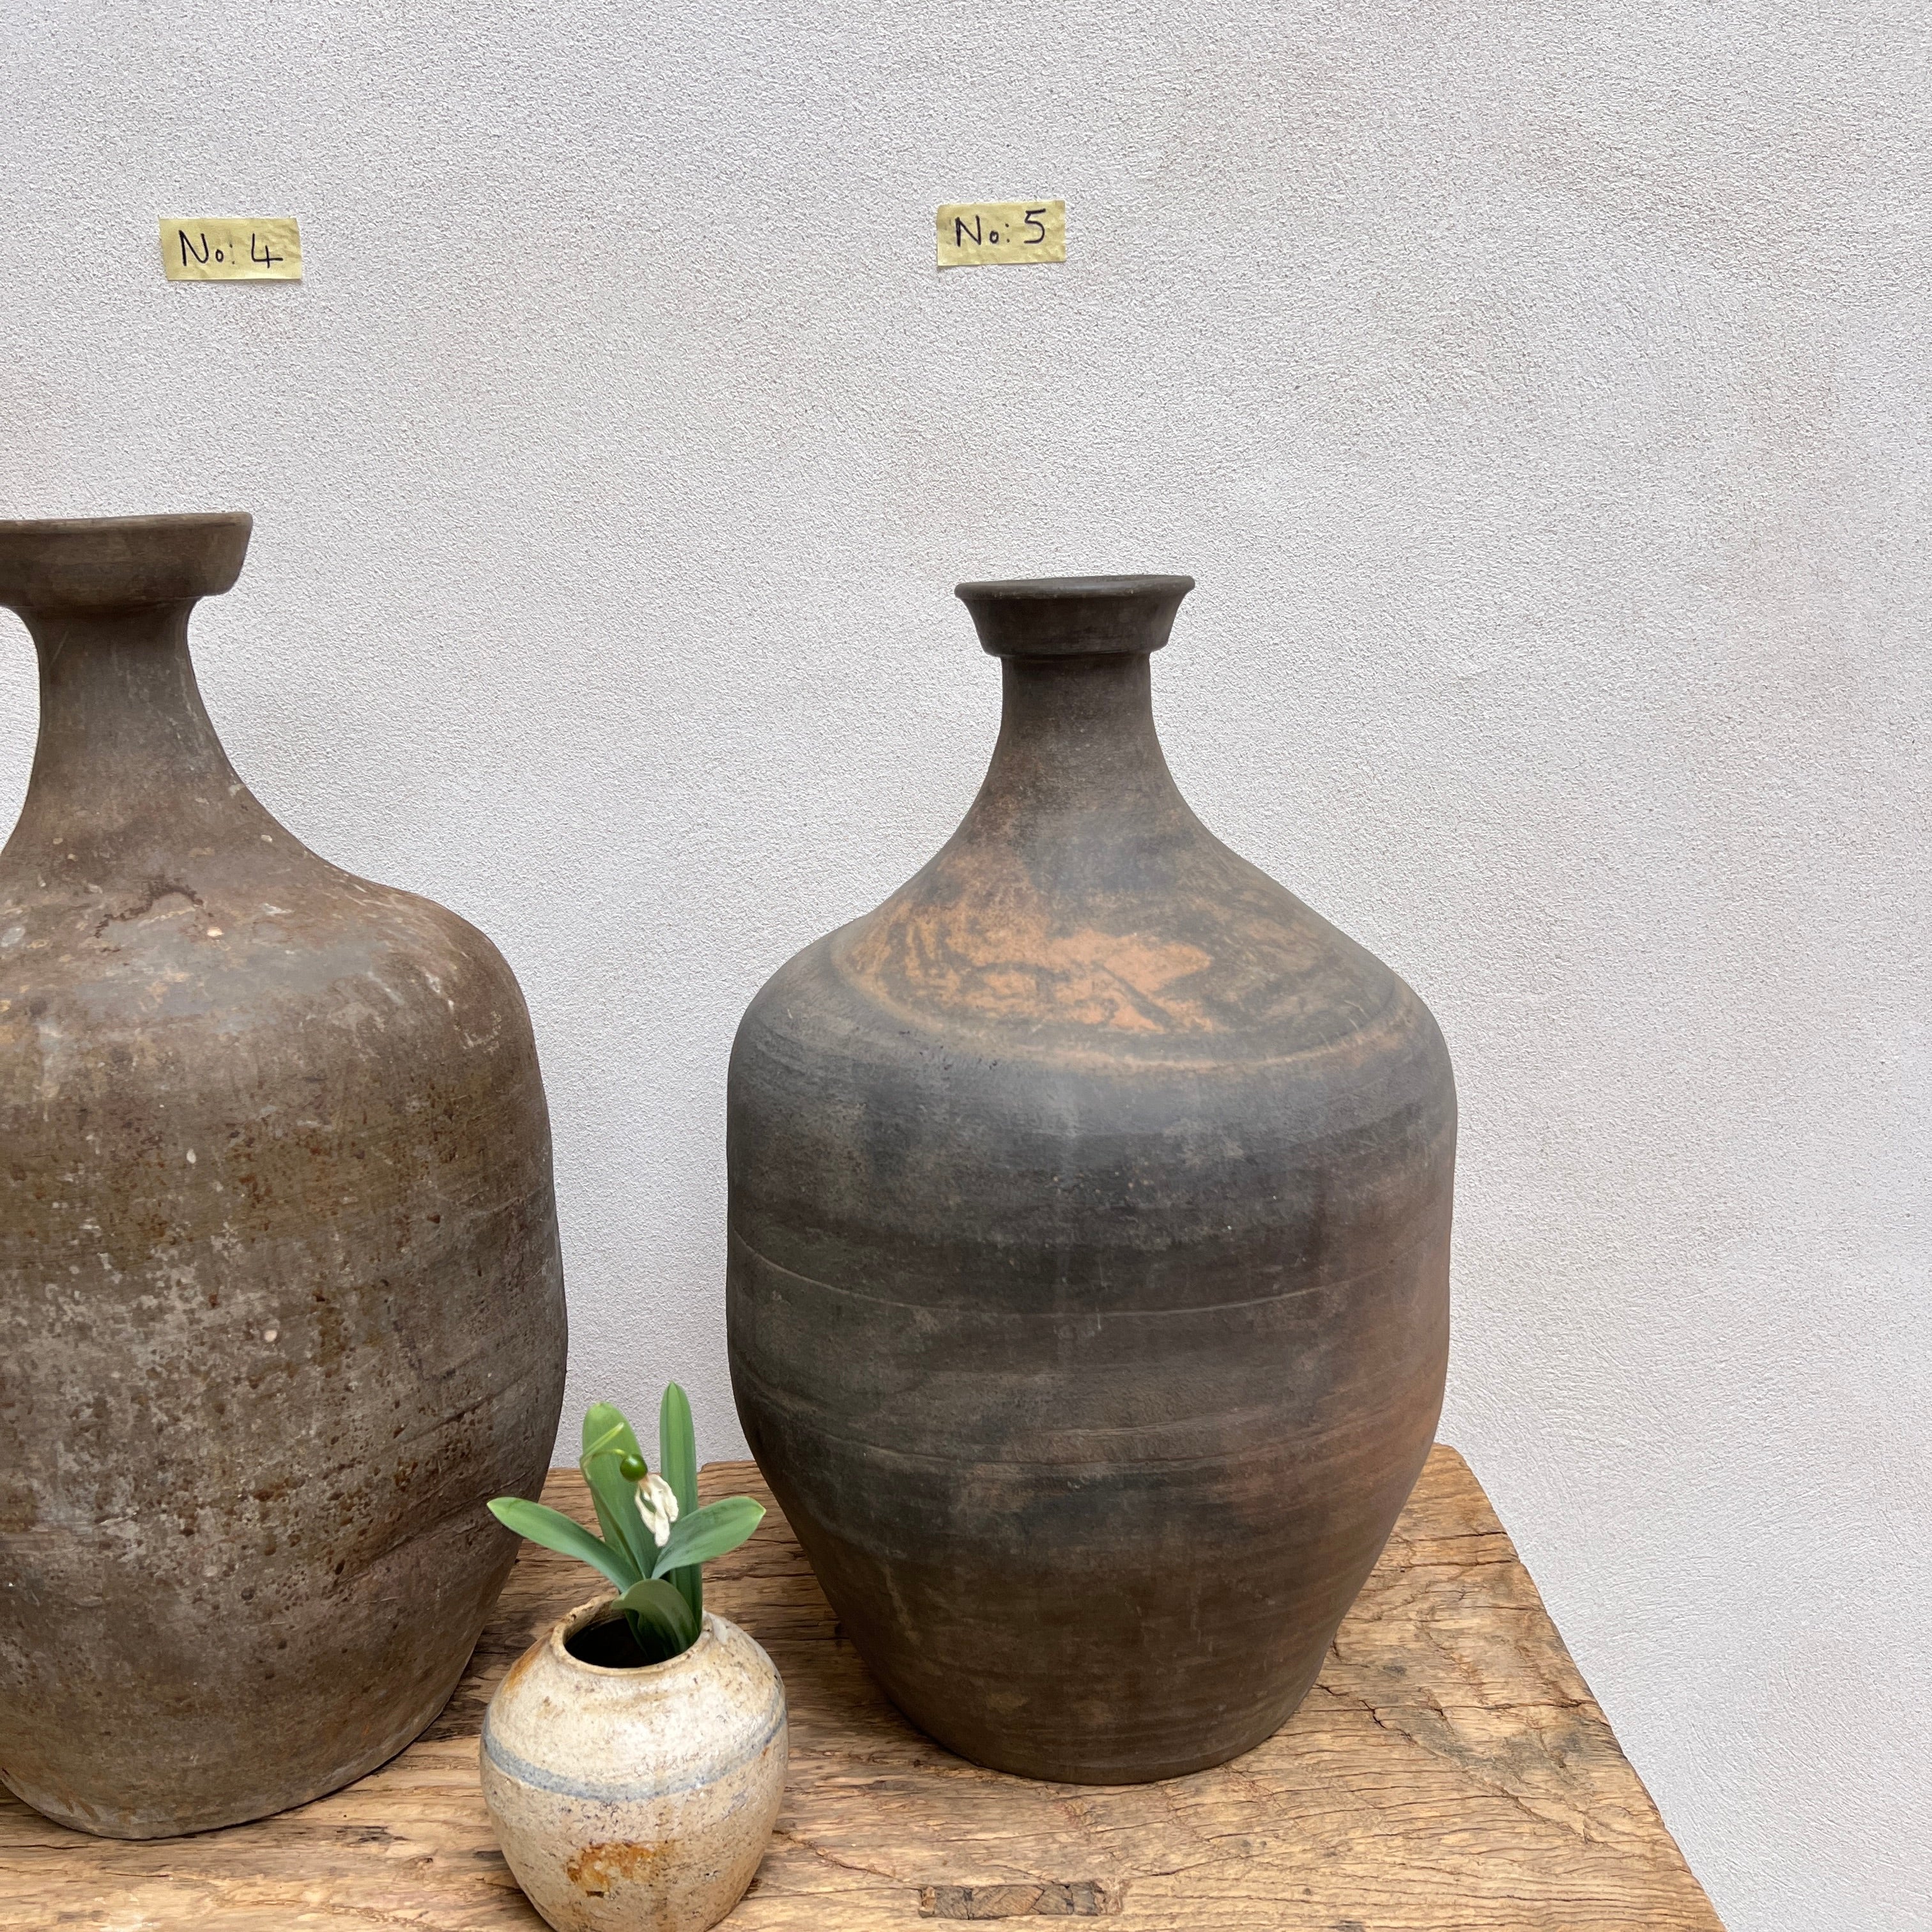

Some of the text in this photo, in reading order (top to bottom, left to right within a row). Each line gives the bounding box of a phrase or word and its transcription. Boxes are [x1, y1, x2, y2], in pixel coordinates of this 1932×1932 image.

[954, 208, 1046, 247] No: 5
[178, 229, 284, 269] No: 4
